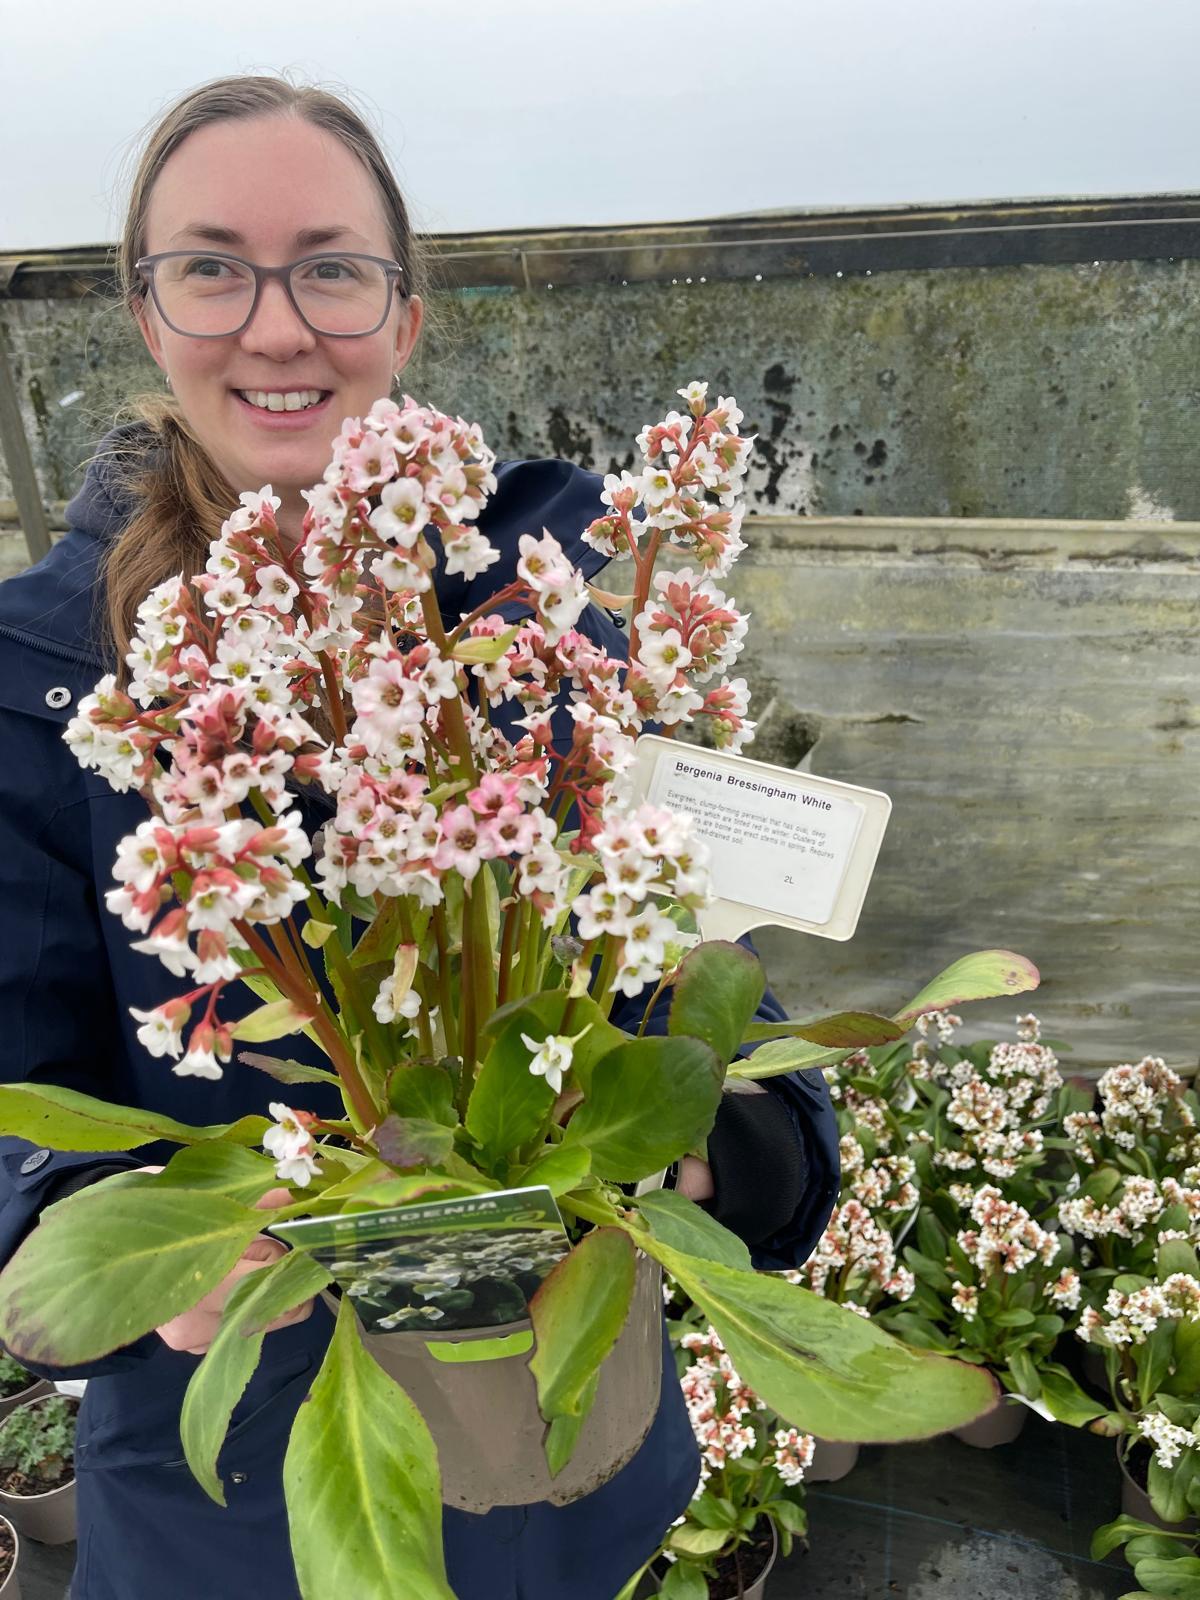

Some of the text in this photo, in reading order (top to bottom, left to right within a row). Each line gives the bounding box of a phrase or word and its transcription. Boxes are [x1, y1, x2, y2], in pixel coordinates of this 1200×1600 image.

[675, 761, 832, 811] Bergenia Bressingham White
[702, 819, 713, 828] are
[733, 827, 743, 835] on
[779, 838, 787, 847] in
[703, 810, 721, 820] which
[721, 815, 732, 823] are
[751, 823, 763, 832] red
[763, 824, 771, 834] in
[817, 838, 826, 847] of
[769, 817, 782, 827] that
[783, 875, 794, 885] 2L
